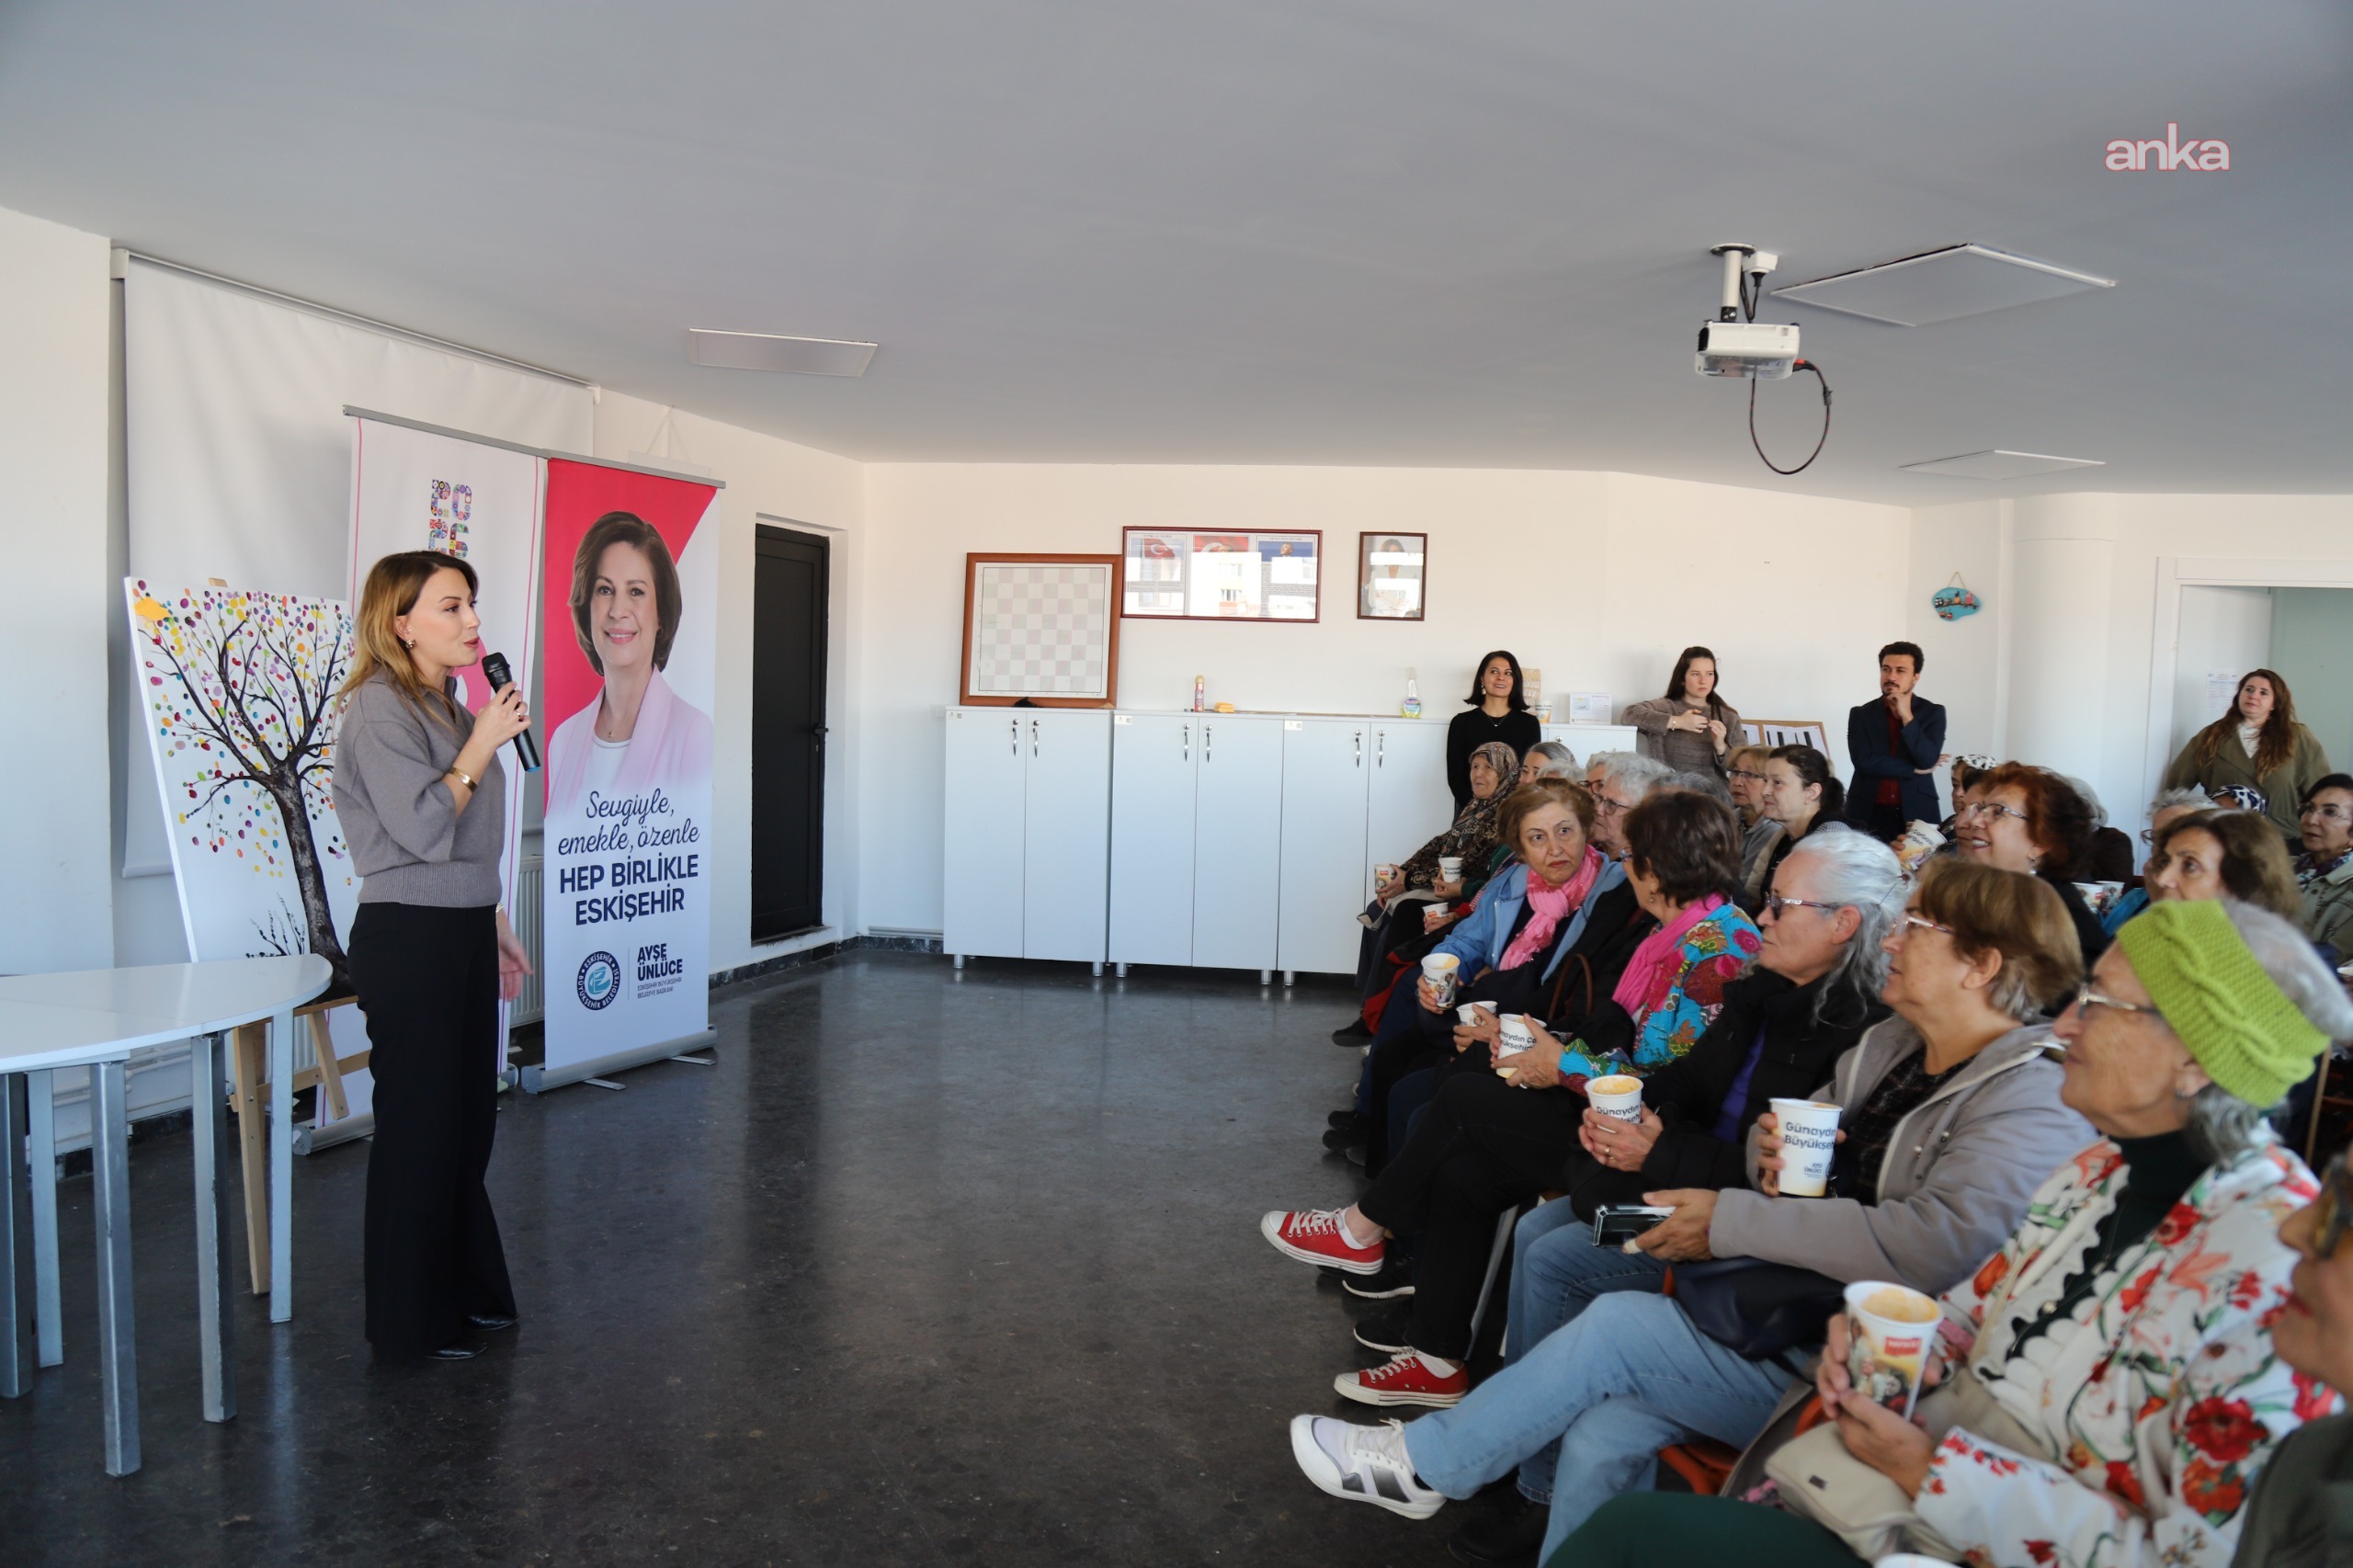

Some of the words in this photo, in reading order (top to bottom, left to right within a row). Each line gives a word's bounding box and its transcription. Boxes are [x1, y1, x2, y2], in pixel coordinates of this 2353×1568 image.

[585, 788, 674, 827] Sevgiyle,
[558, 823, 633, 856] emekle,
[637, 817, 700, 847] özenle
[560, 864, 605, 894] HEP
[611, 852, 699, 888] BİRLİKLE
[575, 882, 685, 926] ESKİŞEHİR
[584, 953, 613, 969] ESKİŞEHİR
[637, 943, 666, 962] AYŞE
[637, 958, 683, 982] ÜNLÜCE
[577, 975, 601, 1008] BÜYÜKŞEHİR
